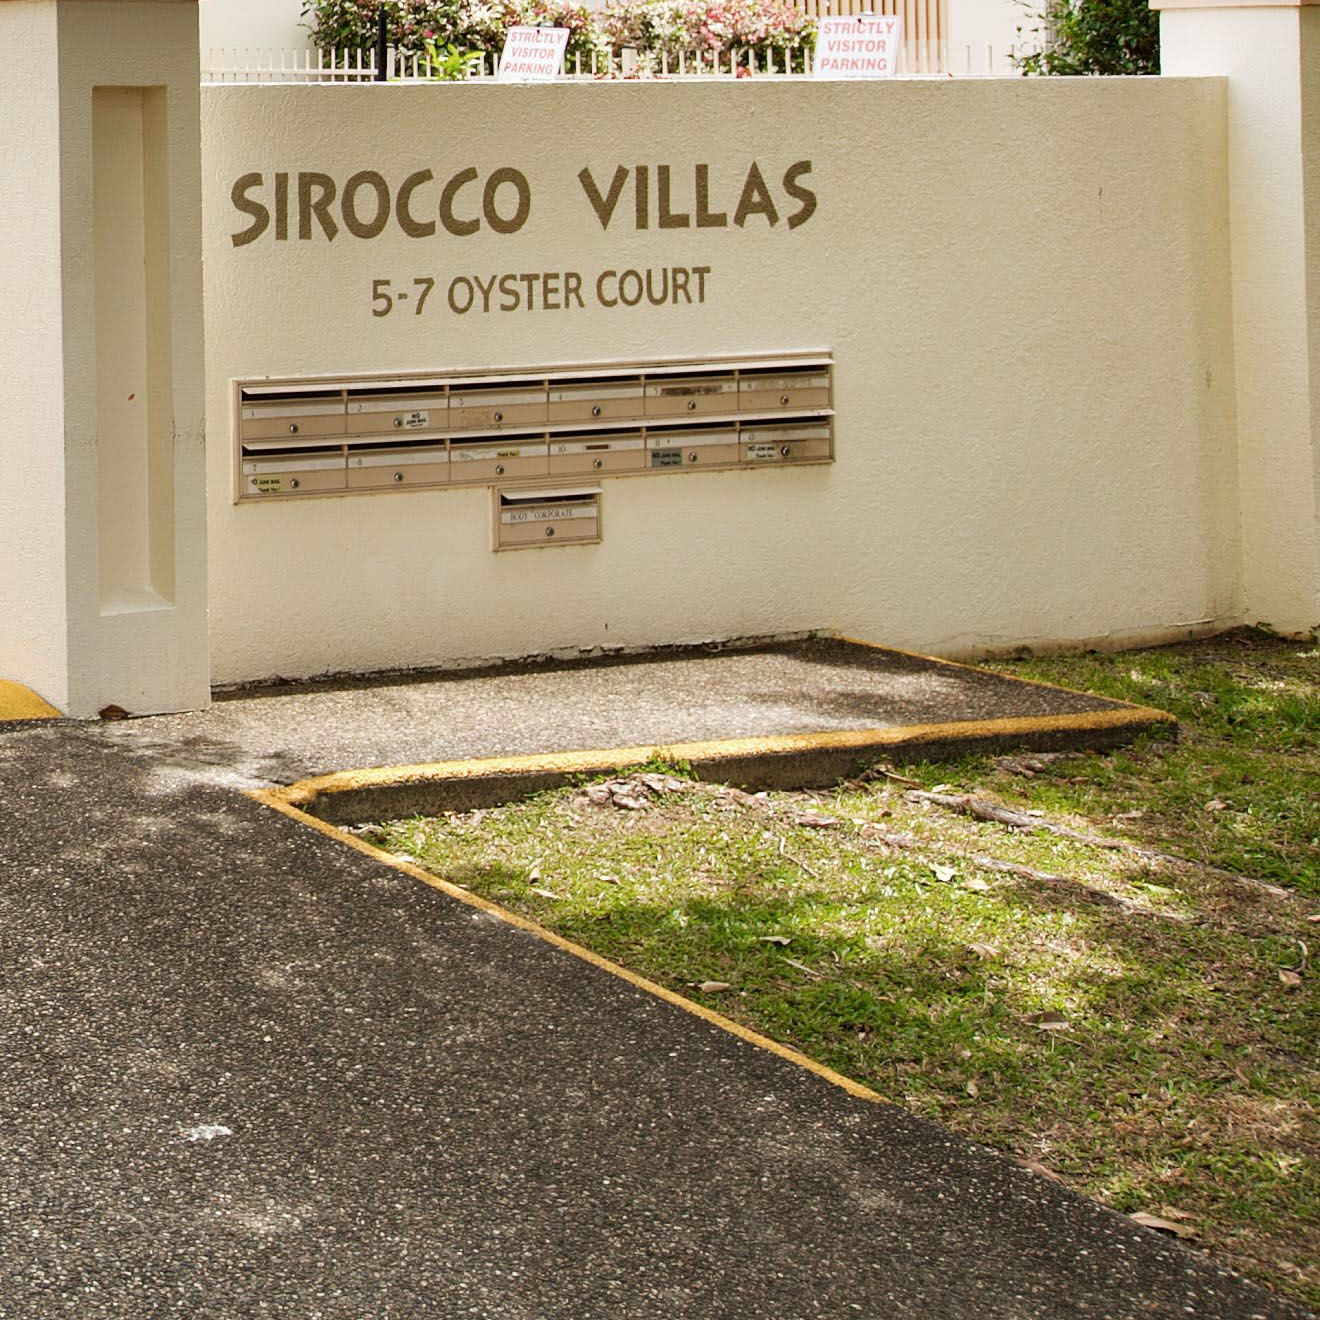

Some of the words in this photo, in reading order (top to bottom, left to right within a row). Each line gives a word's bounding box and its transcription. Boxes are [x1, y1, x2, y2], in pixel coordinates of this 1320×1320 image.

[823, 22, 895, 34] STRICTLY
[510, 31, 565, 44] STRICTLY
[511, 47, 555, 59] VISITOR
[827, 40, 887, 53] VISITOR
[503, 61, 554, 75] PARKING
[820, 57, 888, 71] PARKING
[231, 166, 531, 248] SIROCCO
[577, 159, 818, 232] VILLAS
[371, 278, 435, 318] 5-7
[447, 271, 586, 315] OYSTER
[596, 266, 712, 308] COURT
